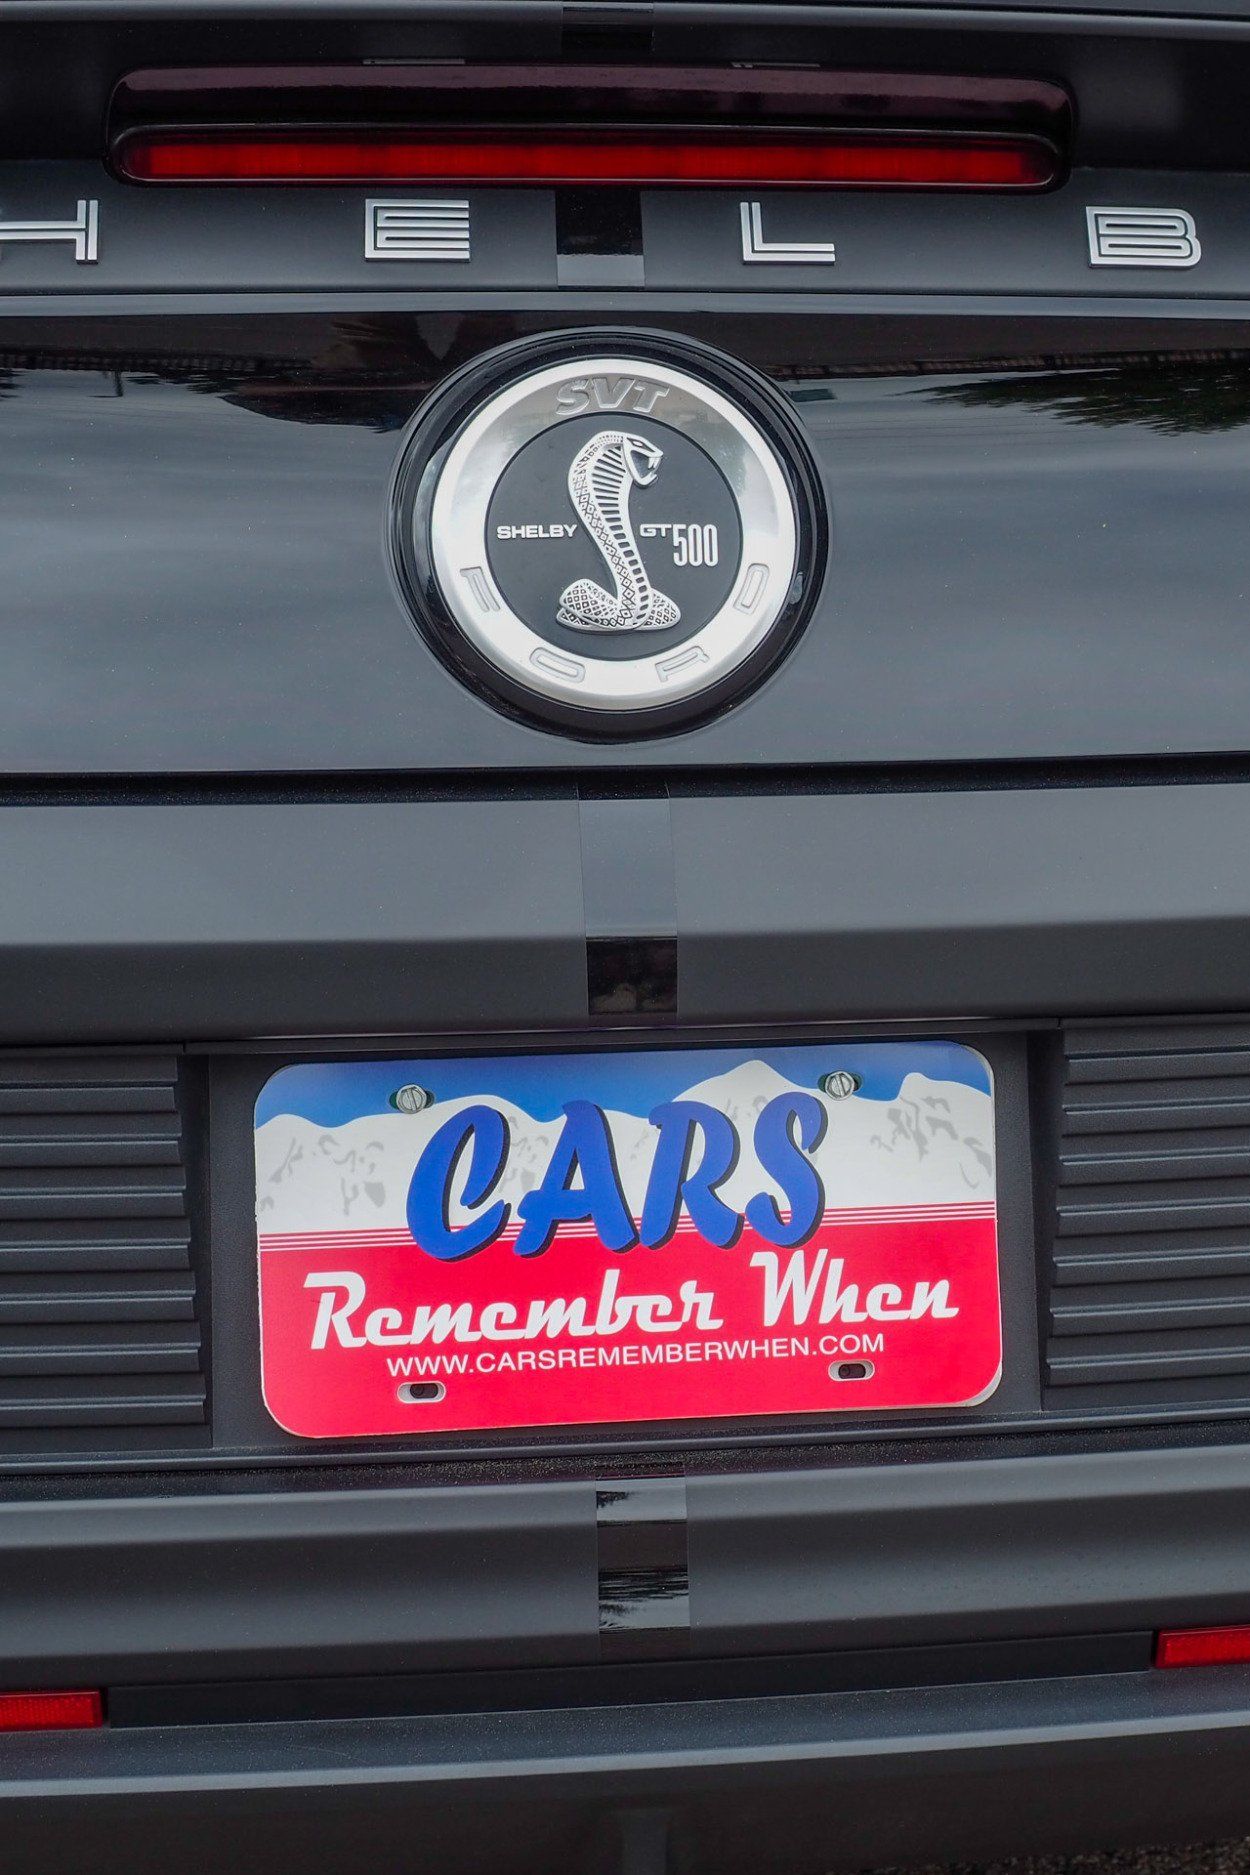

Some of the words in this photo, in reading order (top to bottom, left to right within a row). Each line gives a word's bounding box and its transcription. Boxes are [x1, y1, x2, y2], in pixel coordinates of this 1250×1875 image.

[556, 377, 669, 414] SVT
[496, 524, 578, 539] SHELBY
[460, 564, 769, 683] FORD
[406, 1091, 828, 1262] CARS
[303, 1268, 722, 1350] Remember
[750, 1249, 959, 1327] When
[386, 1333, 884, 1377] WWW.CARSREMEMBERWHEN.COM
